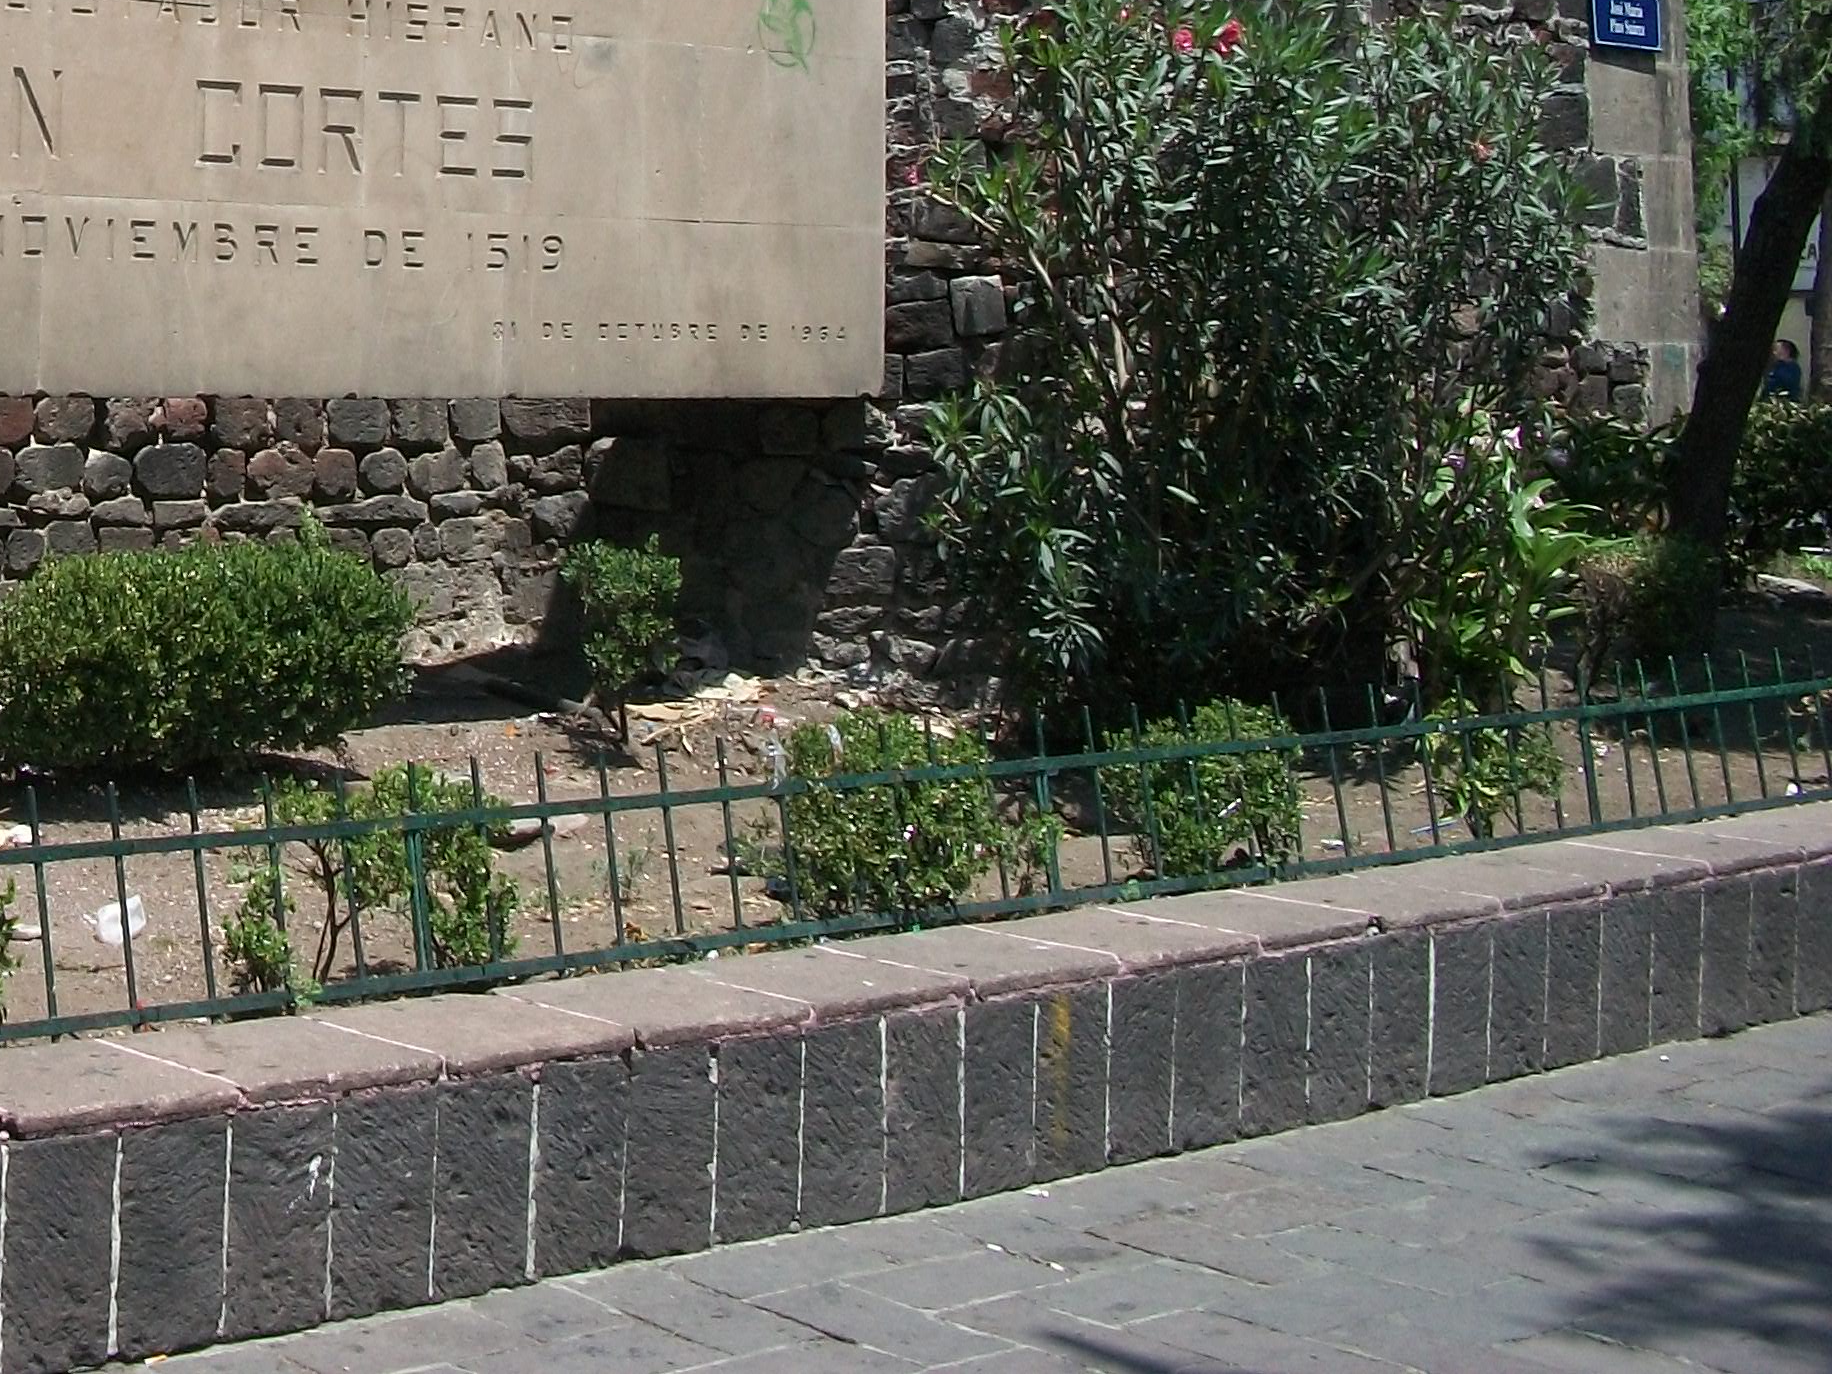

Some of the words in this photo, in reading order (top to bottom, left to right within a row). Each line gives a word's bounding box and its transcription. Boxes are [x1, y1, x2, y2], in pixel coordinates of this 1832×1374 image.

[194, 78, 537, 182] CORTES
[362, 228, 427, 272] DE
[465, 230, 567, 275] 1519
[541, 321, 575, 343] DE
[596, 322, 719, 344] OCTUBRE
[739, 324, 769, 343] DE
